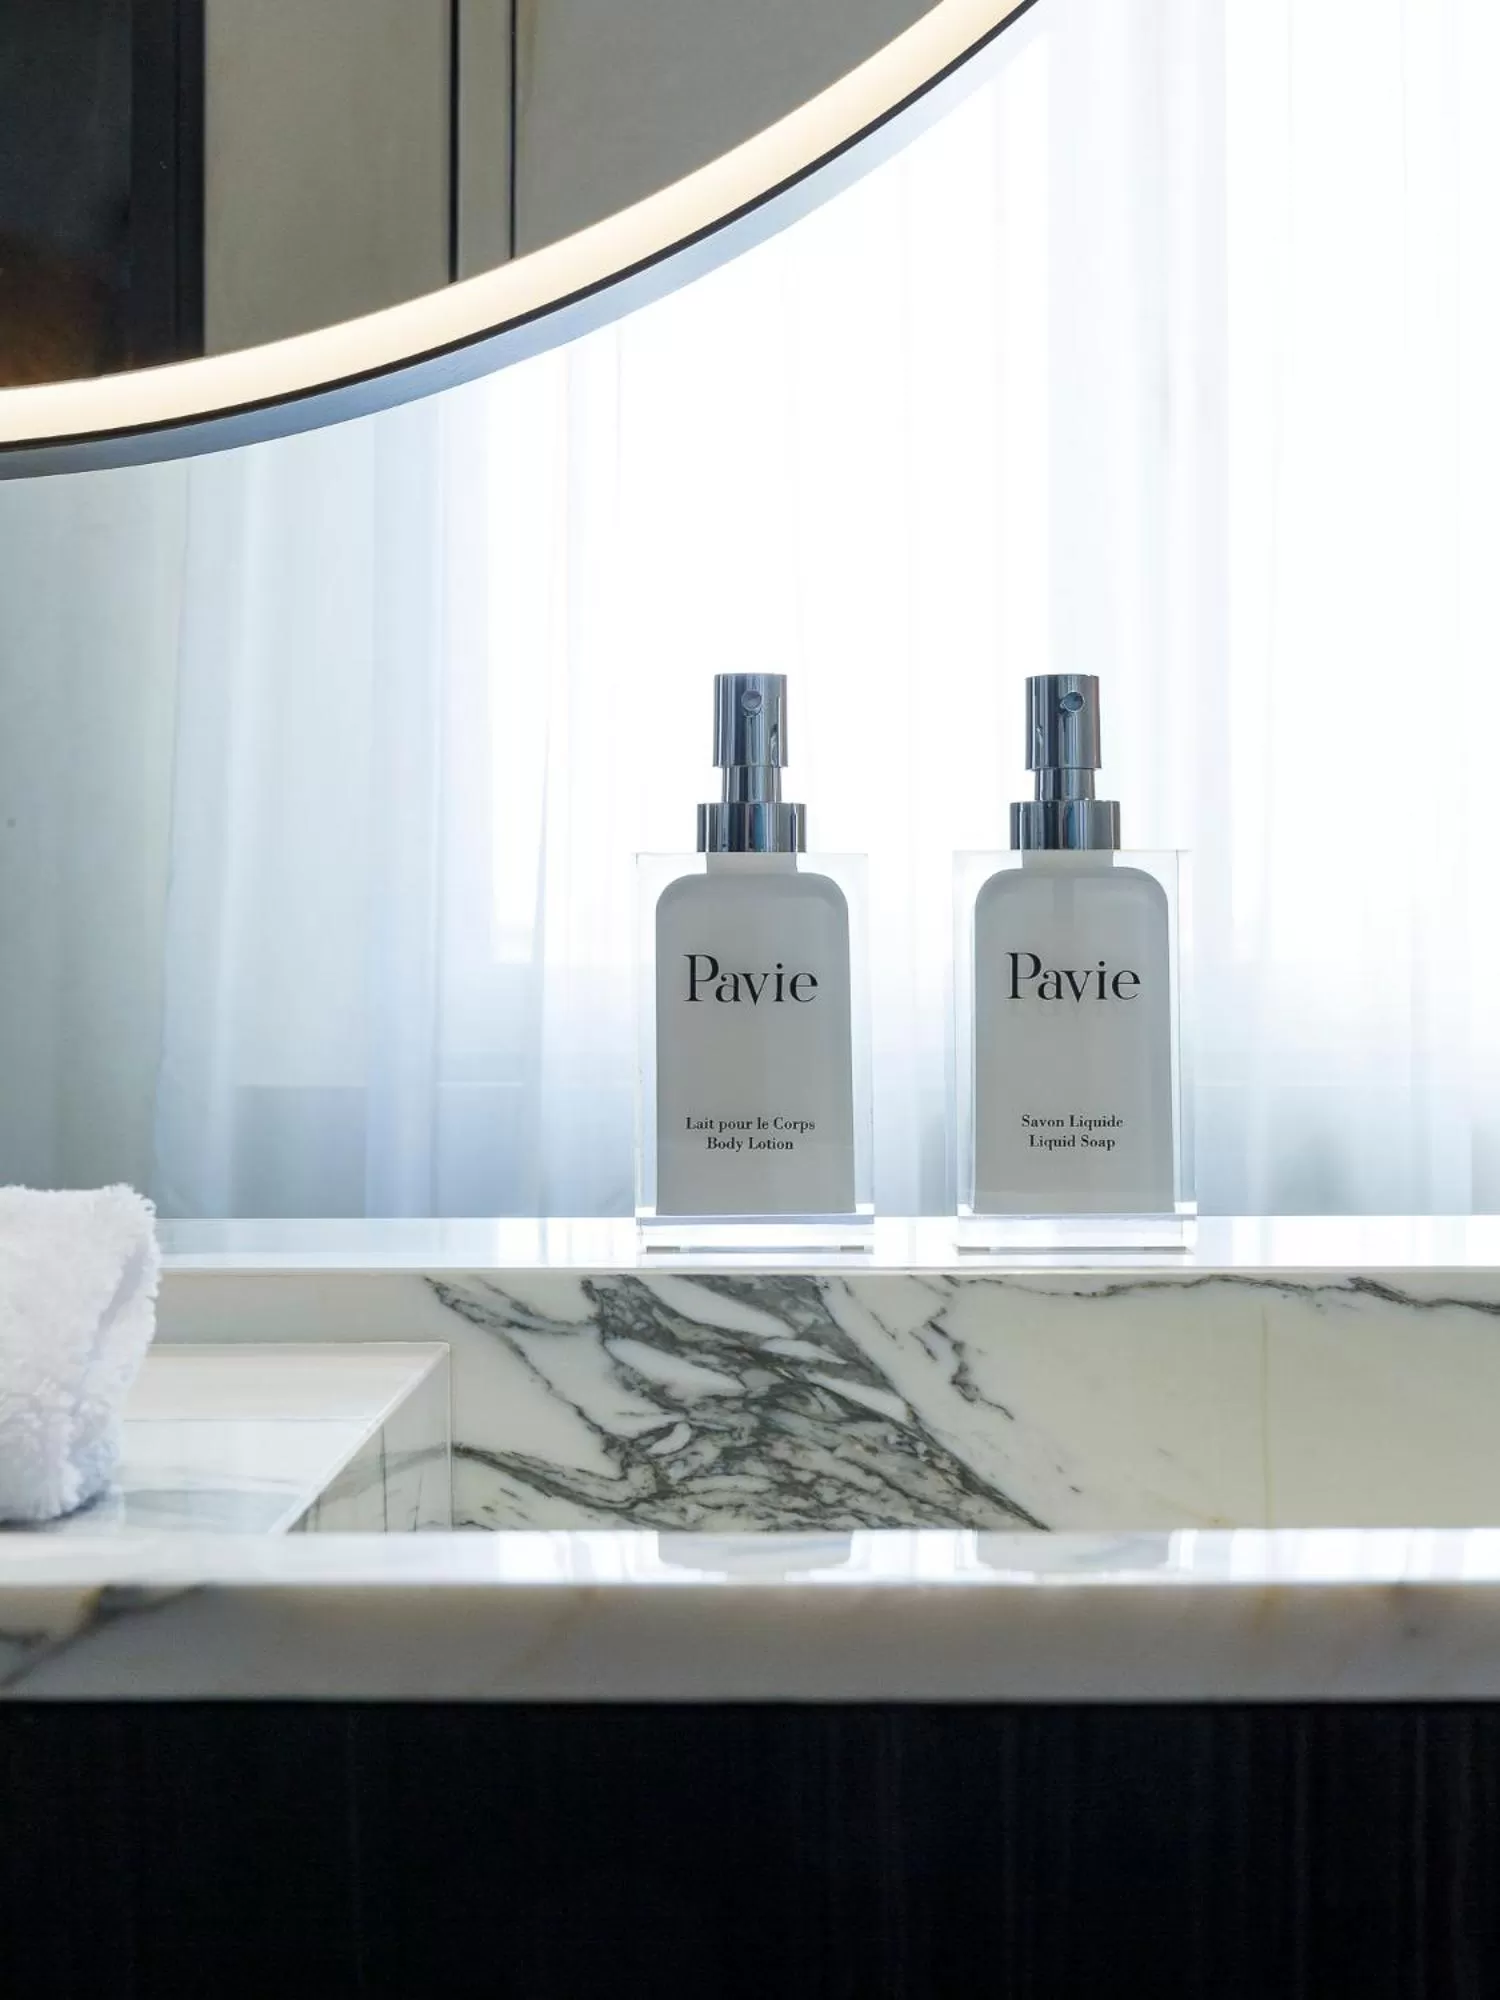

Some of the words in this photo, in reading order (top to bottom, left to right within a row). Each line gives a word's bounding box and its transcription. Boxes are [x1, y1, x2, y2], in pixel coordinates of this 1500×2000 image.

[683, 954, 819, 1004] Pavie
[1007, 951, 1141, 1003] Pavie
[685, 1116, 715, 1130] Lait
[718, 1120, 753, 1133] pour
[756, 1116, 769, 1130] le
[773, 1116, 816, 1133] Corps
[1021, 1114, 1065, 1128] Savon
[1069, 1114, 1124, 1131] Liquide
[706, 1136, 743, 1152] Body
[748, 1136, 794, 1150] Lotion
[1029, 1134, 1076, 1151] Liquid
[1080, 1134, 1116, 1151] Soap
